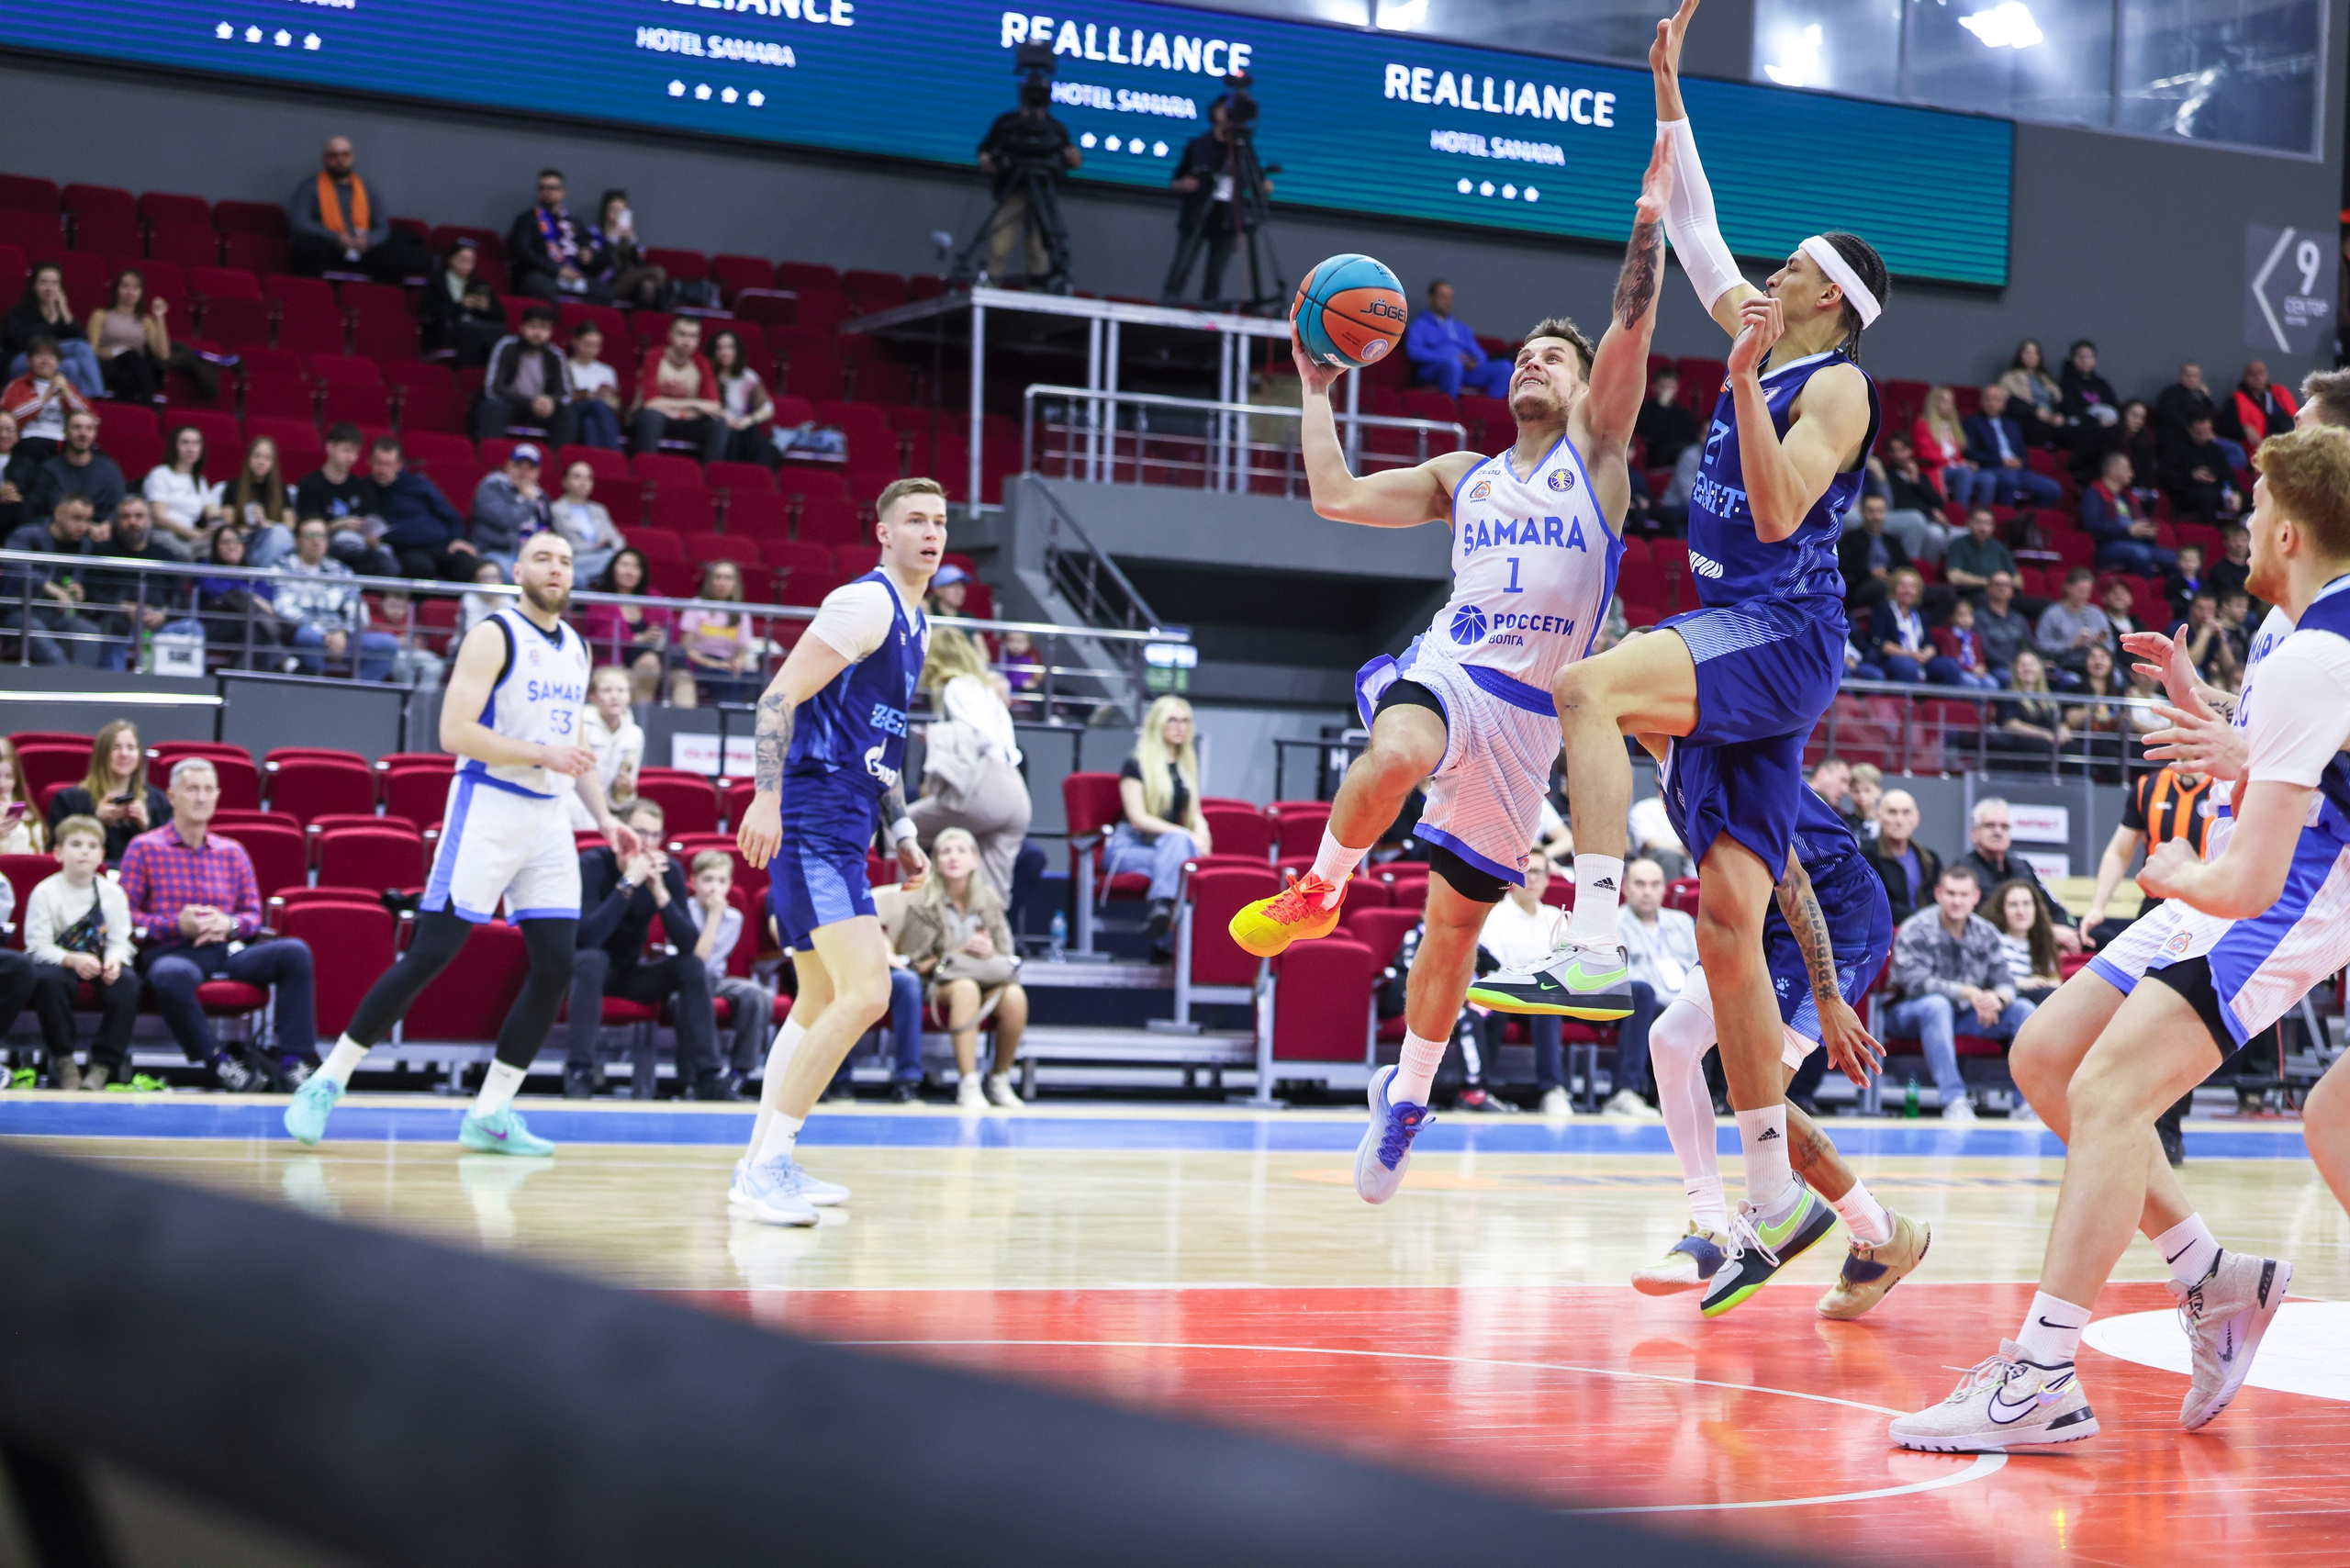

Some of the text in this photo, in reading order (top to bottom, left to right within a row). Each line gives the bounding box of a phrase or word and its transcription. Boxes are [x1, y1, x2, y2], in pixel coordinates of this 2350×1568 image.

[635, 26, 797, 68] HOTEL SAMARA
[1001, 11, 1252, 77] REALLIANCE
[1051, 81, 1198, 120] HOTEL SAMARA
[1384, 63, 1617, 128] REALLIANCE
[1430, 129, 1491, 157] HOTEL
[2297, 240, 2321, 296] 9
[1693, 470, 1747, 519] ENIT
[1463, 515, 1587, 556] SAMARA
[1503, 557, 1524, 593] 1
[1488, 633, 1524, 646] ВОЛГА
[1494, 613, 1575, 636] РОССЕТИ
[527, 679, 582, 703] SAMAR
[1593, 882, 1617, 891] adidas
[1757, 1134, 1780, 1142] adidas
